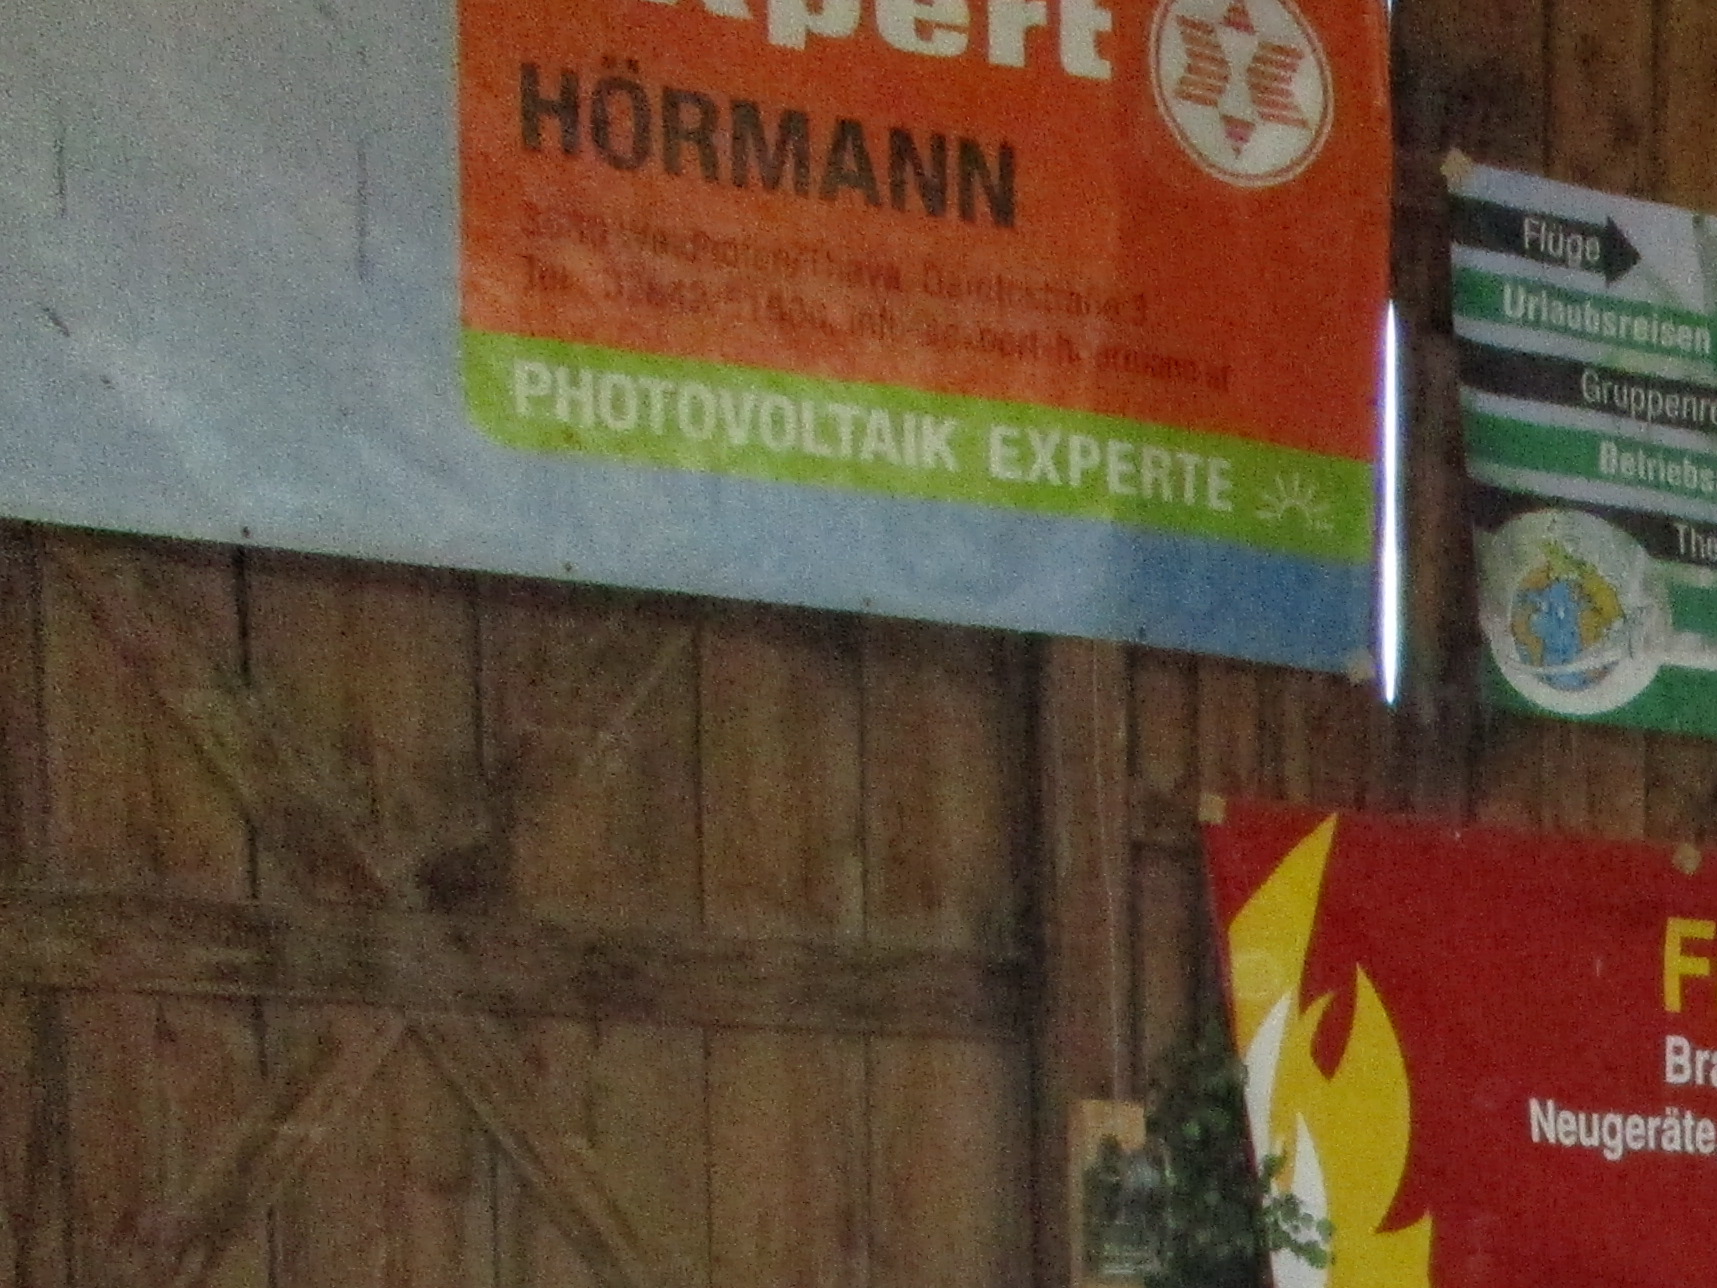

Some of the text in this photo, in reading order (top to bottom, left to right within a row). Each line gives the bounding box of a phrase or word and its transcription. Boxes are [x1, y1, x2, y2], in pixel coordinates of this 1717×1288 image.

[642, 0, 1114, 81] pert
[519, 57, 1018, 229] HÖRMANN
[1522, 217, 1600, 266] Flüge
[1502, 281, 1711, 357] Urlaubsreisen
[514, 359, 1234, 514] PHOTOVOLTAIK EXPERTE
